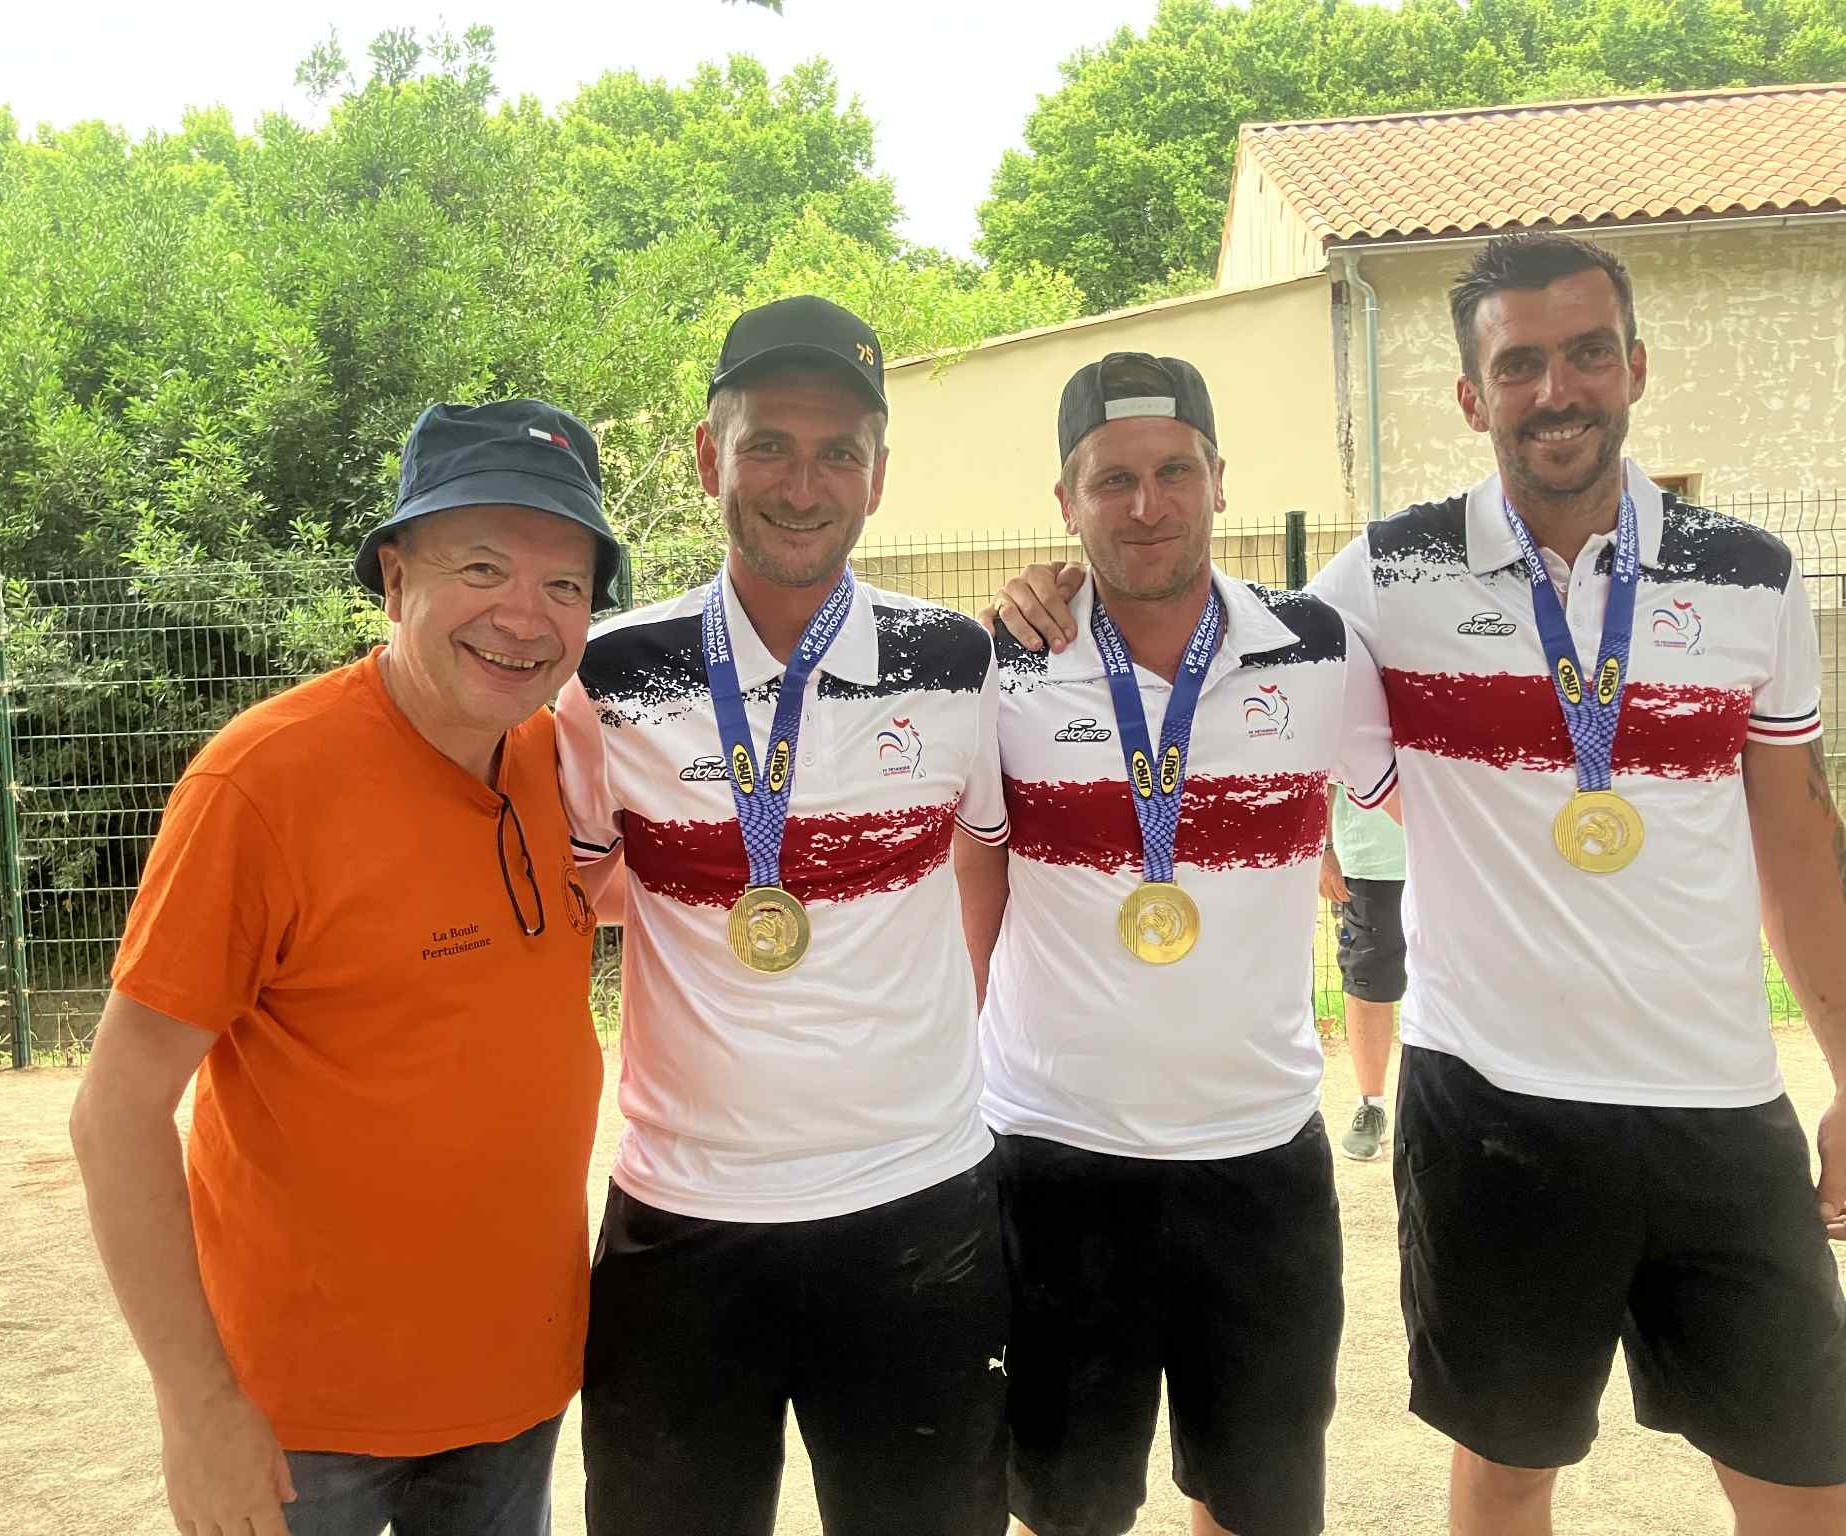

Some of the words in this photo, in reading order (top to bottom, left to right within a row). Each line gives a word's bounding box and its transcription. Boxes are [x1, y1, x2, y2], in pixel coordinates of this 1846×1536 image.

[856, 343, 874, 366] 75
[1620, 574, 1629, 583] &
[1626, 555, 1636, 576] JEU
[801, 637, 814, 652] FF
[810, 581, 848, 638] PETANQUE
[802, 653, 812, 661] &
[812, 636, 828, 655] JEU
[1101, 616, 1130, 674] PETANQUE
[1185, 651, 1198, 666] FF
[1196, 650, 1209, 668] JEU
[1561, 665, 1580, 695] OBUT
[1601, 665, 1616, 696] OBUT
[1054, 728, 1112, 742] eldera
[735, 752, 753, 785] OBUT
[771, 749, 787, 783] OBUT
[1135, 758, 1151, 789] OBUT
[1162, 754, 1178, 785] OBUT
[432, 932, 447, 942] La
[450, 923, 479, 938] Boule
[421, 938, 492, 960] Pertuisienne
